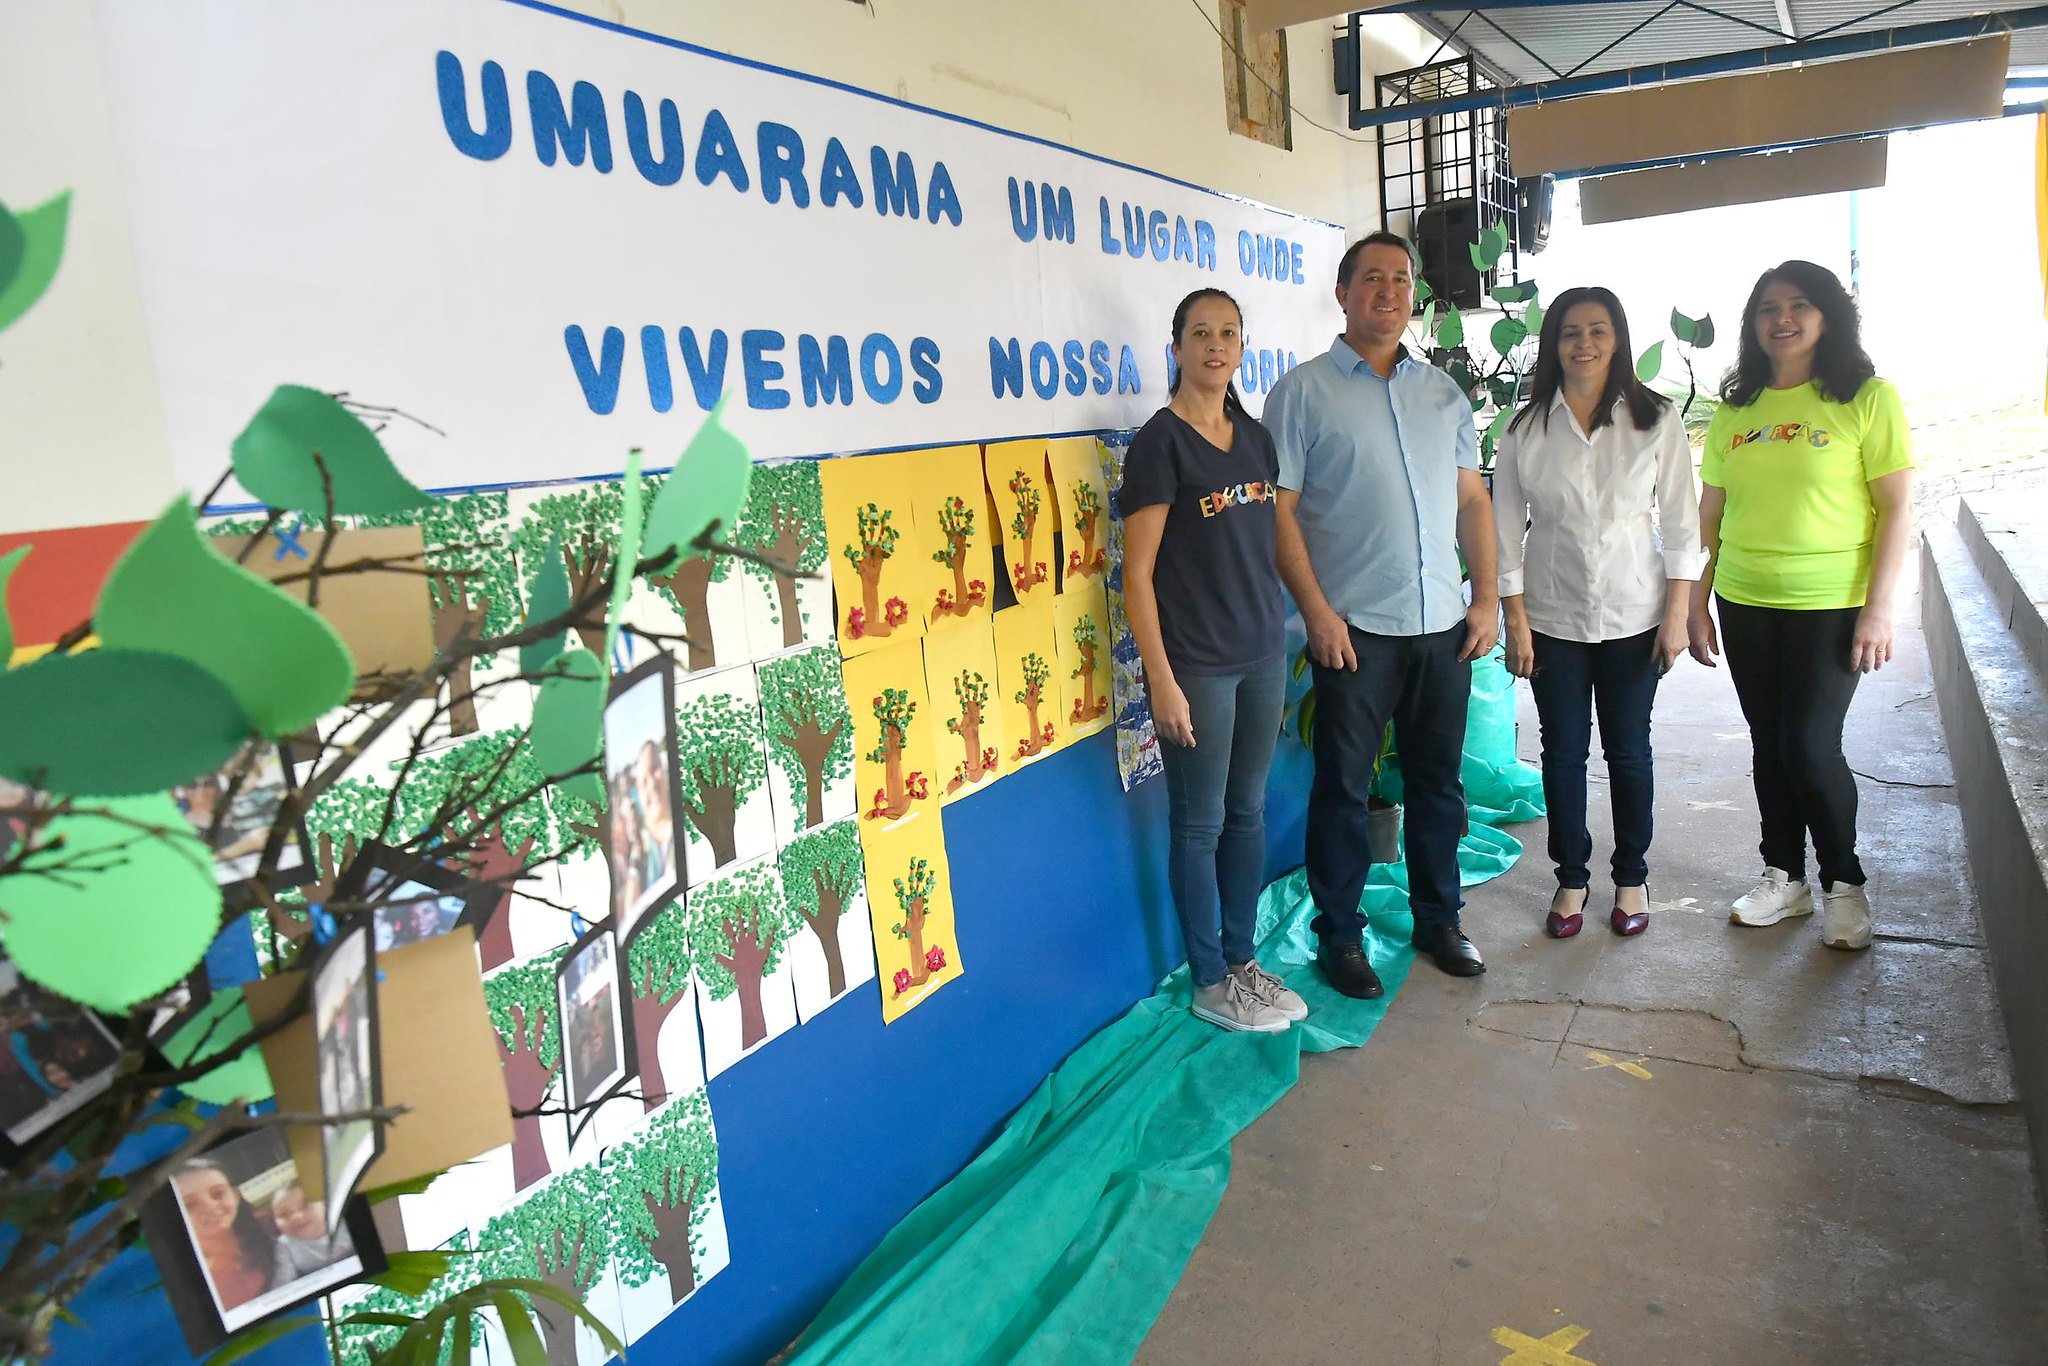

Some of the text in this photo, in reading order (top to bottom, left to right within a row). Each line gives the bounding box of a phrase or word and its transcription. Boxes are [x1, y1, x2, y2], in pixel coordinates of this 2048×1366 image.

[435, 50, 1305, 285] UMUARAMA UM LUGAR ONDE
[564, 324, 944, 416] VIVEMOS
[989, 336, 1142, 401] NOSSA
